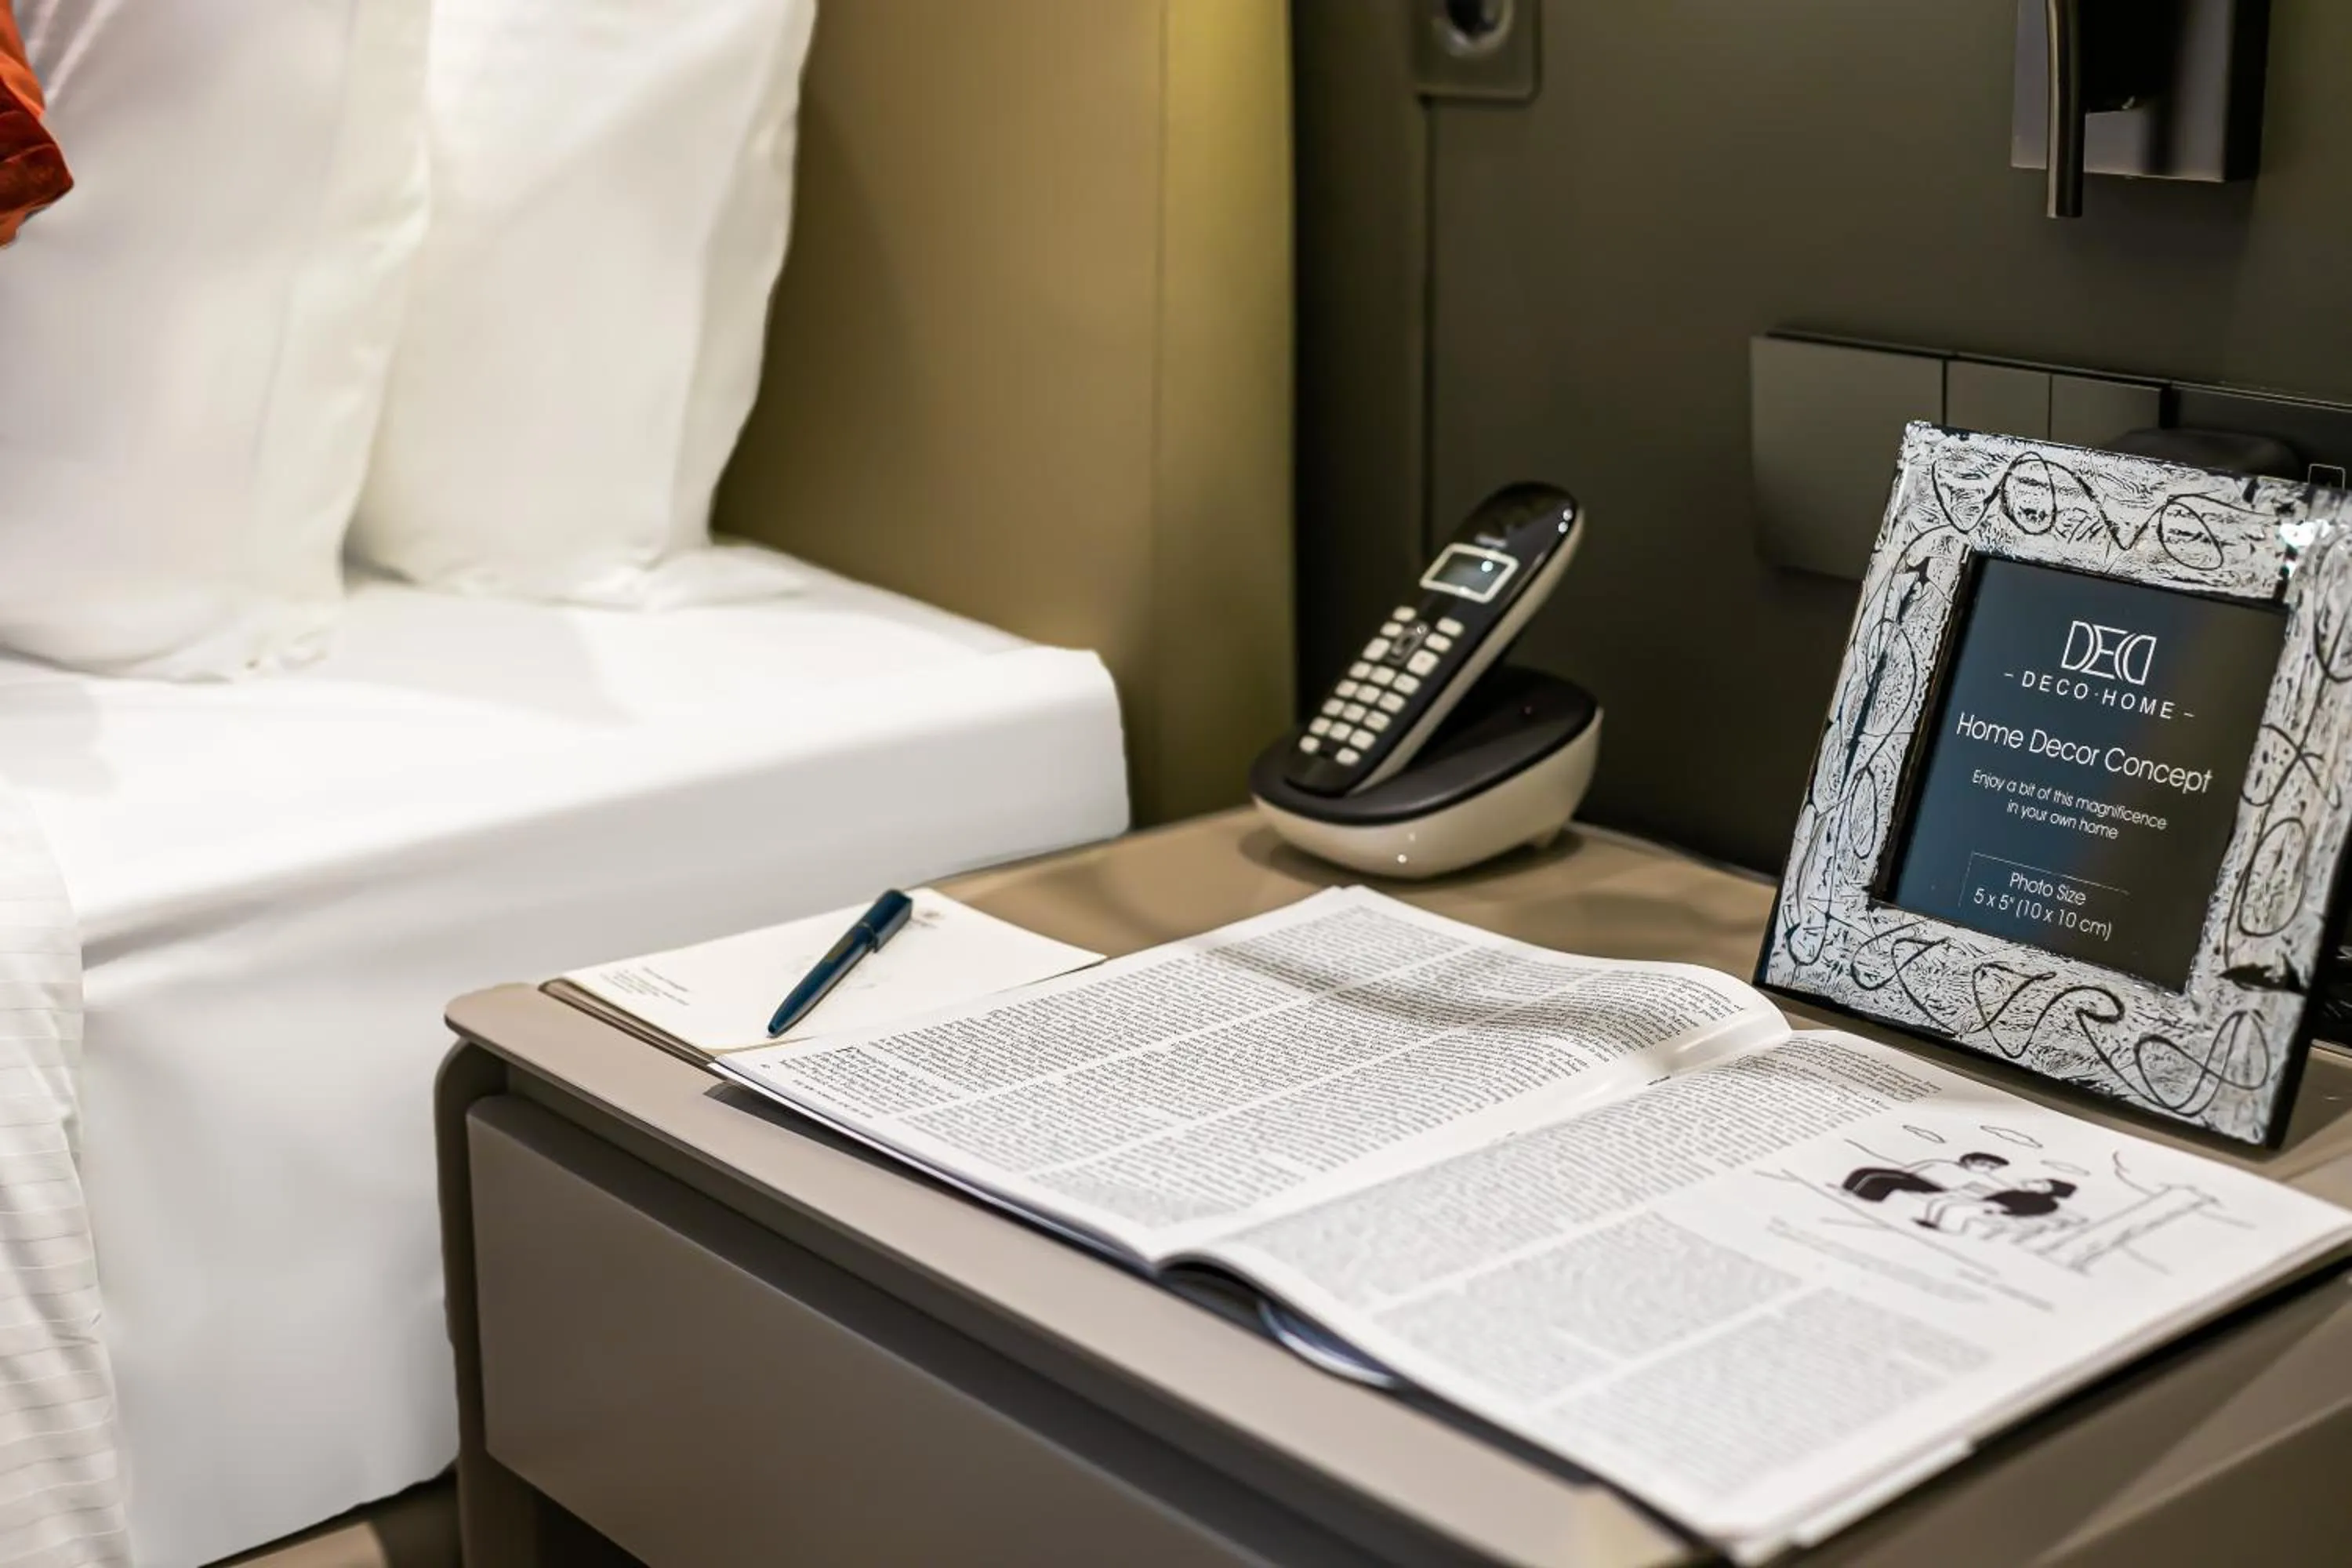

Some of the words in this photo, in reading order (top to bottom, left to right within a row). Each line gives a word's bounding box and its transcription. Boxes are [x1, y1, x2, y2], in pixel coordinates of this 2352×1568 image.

[1956, 711, 2024, 749] Home
[2029, 728, 2100, 766] Decor
[2105, 747, 2212, 794] Concept
[1973, 769, 2005, 791] Enjoy
[2006, 779, 2017, 793] a
[2019, 780, 2036, 797] bit
[2037, 787, 2052, 801] of
[2053, 789, 2074, 808] this
[2076, 797, 2168, 830] magnificence
[2006, 799, 2018, 815] in
[2020, 805, 2048, 822] your
[2050, 812, 2077, 829] own
[2078, 818, 2119, 840] home
[1973, 887, 1985, 904] 5
[1986, 894, 1996, 907] x
[2016, 899, 2042, 920] (10
[2042, 909, 2053, 923] x
[2058, 909, 2077, 928] 10
[2078, 918, 2112, 942] cm)
[2009, 871, 2053, 898] Photo
[2056, 884, 2086, 906] Size
